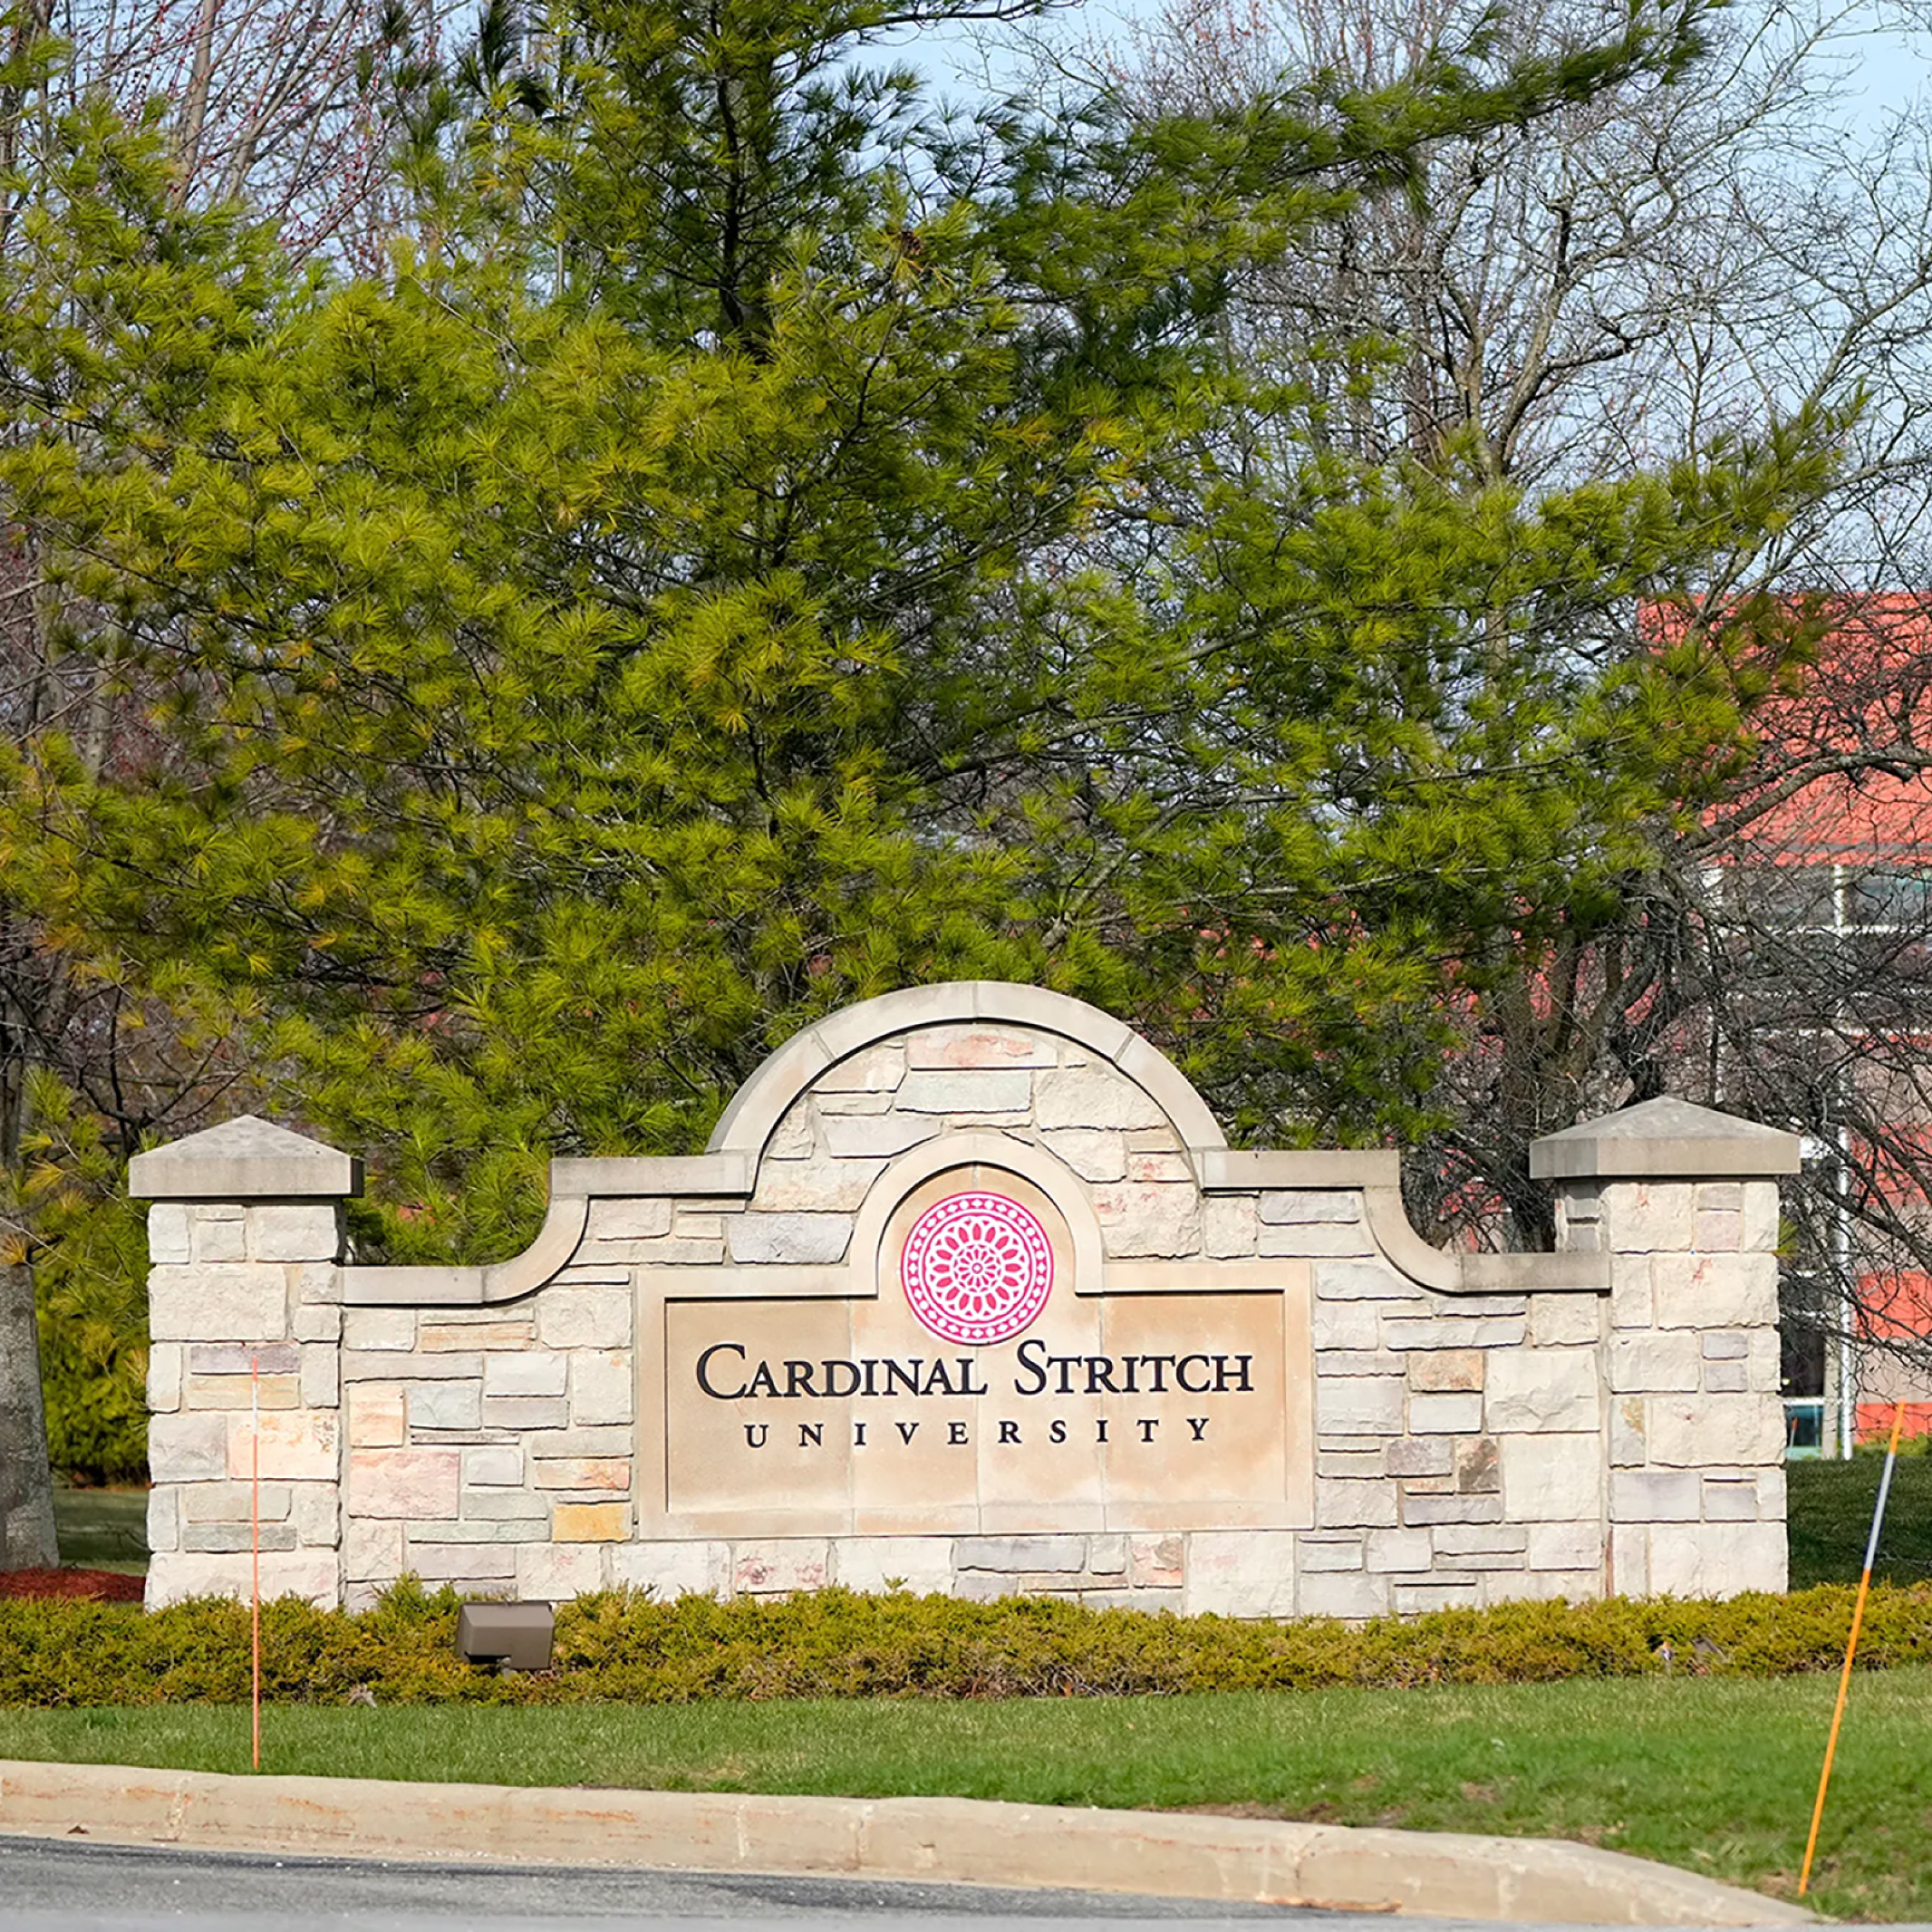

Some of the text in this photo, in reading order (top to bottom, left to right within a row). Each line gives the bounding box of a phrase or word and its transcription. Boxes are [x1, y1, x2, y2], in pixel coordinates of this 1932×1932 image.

[696, 1339, 1255, 1401] CARDINAL STRITCH
[743, 1417, 1210, 1448] UNIVERSITY
